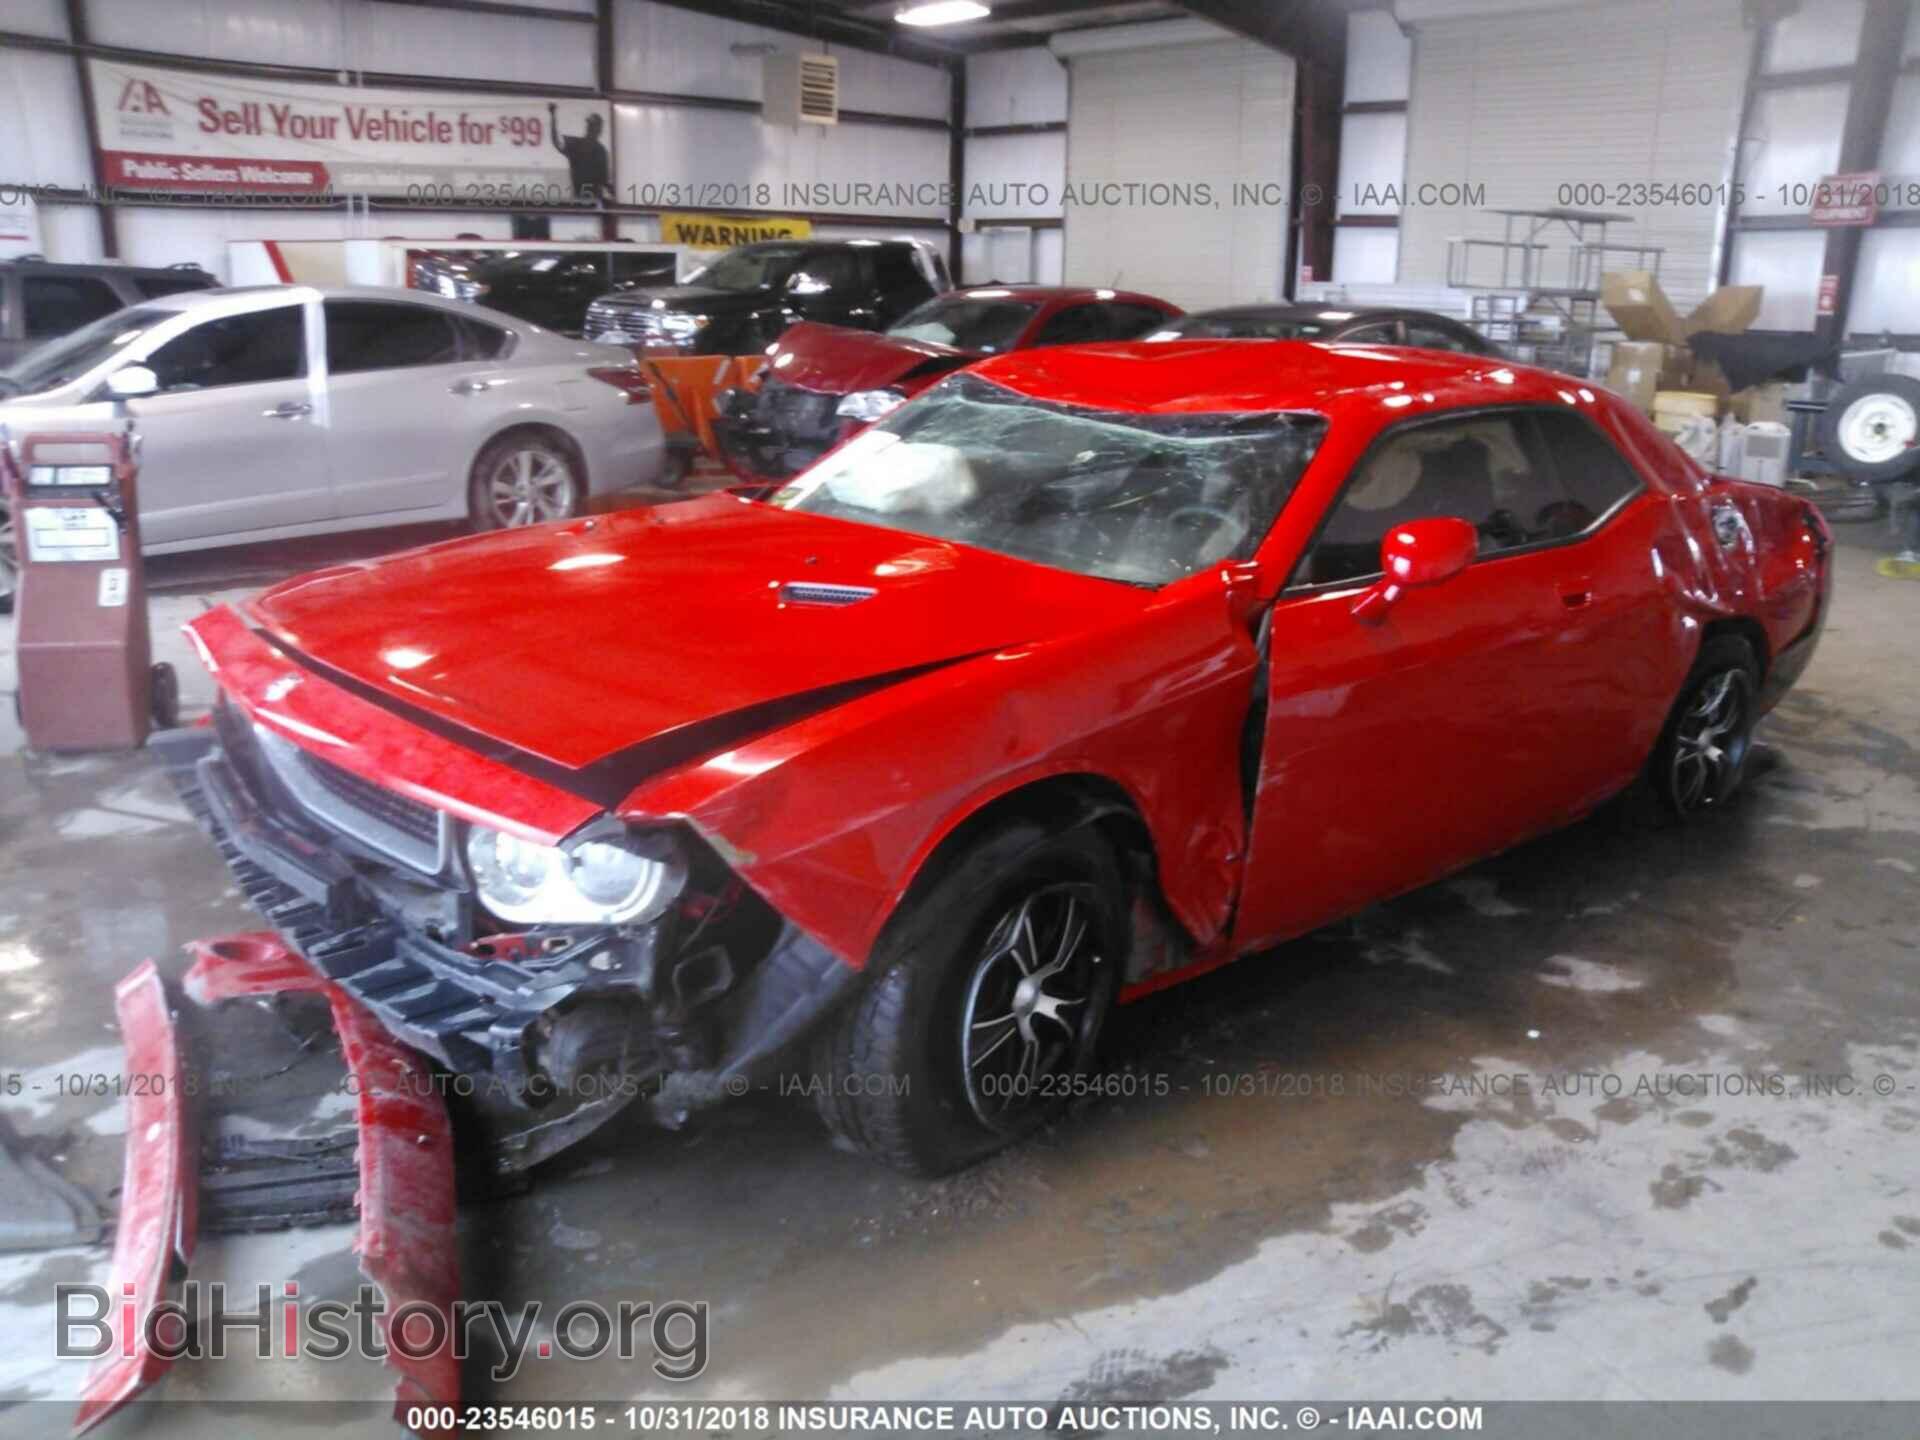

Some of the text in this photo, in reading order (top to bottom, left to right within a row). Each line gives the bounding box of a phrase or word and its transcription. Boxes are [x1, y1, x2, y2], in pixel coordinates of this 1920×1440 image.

[197, 96, 543, 146] Sell Your Vehicle for $99
[121, 159, 315, 185] Public Sellers Welcome
